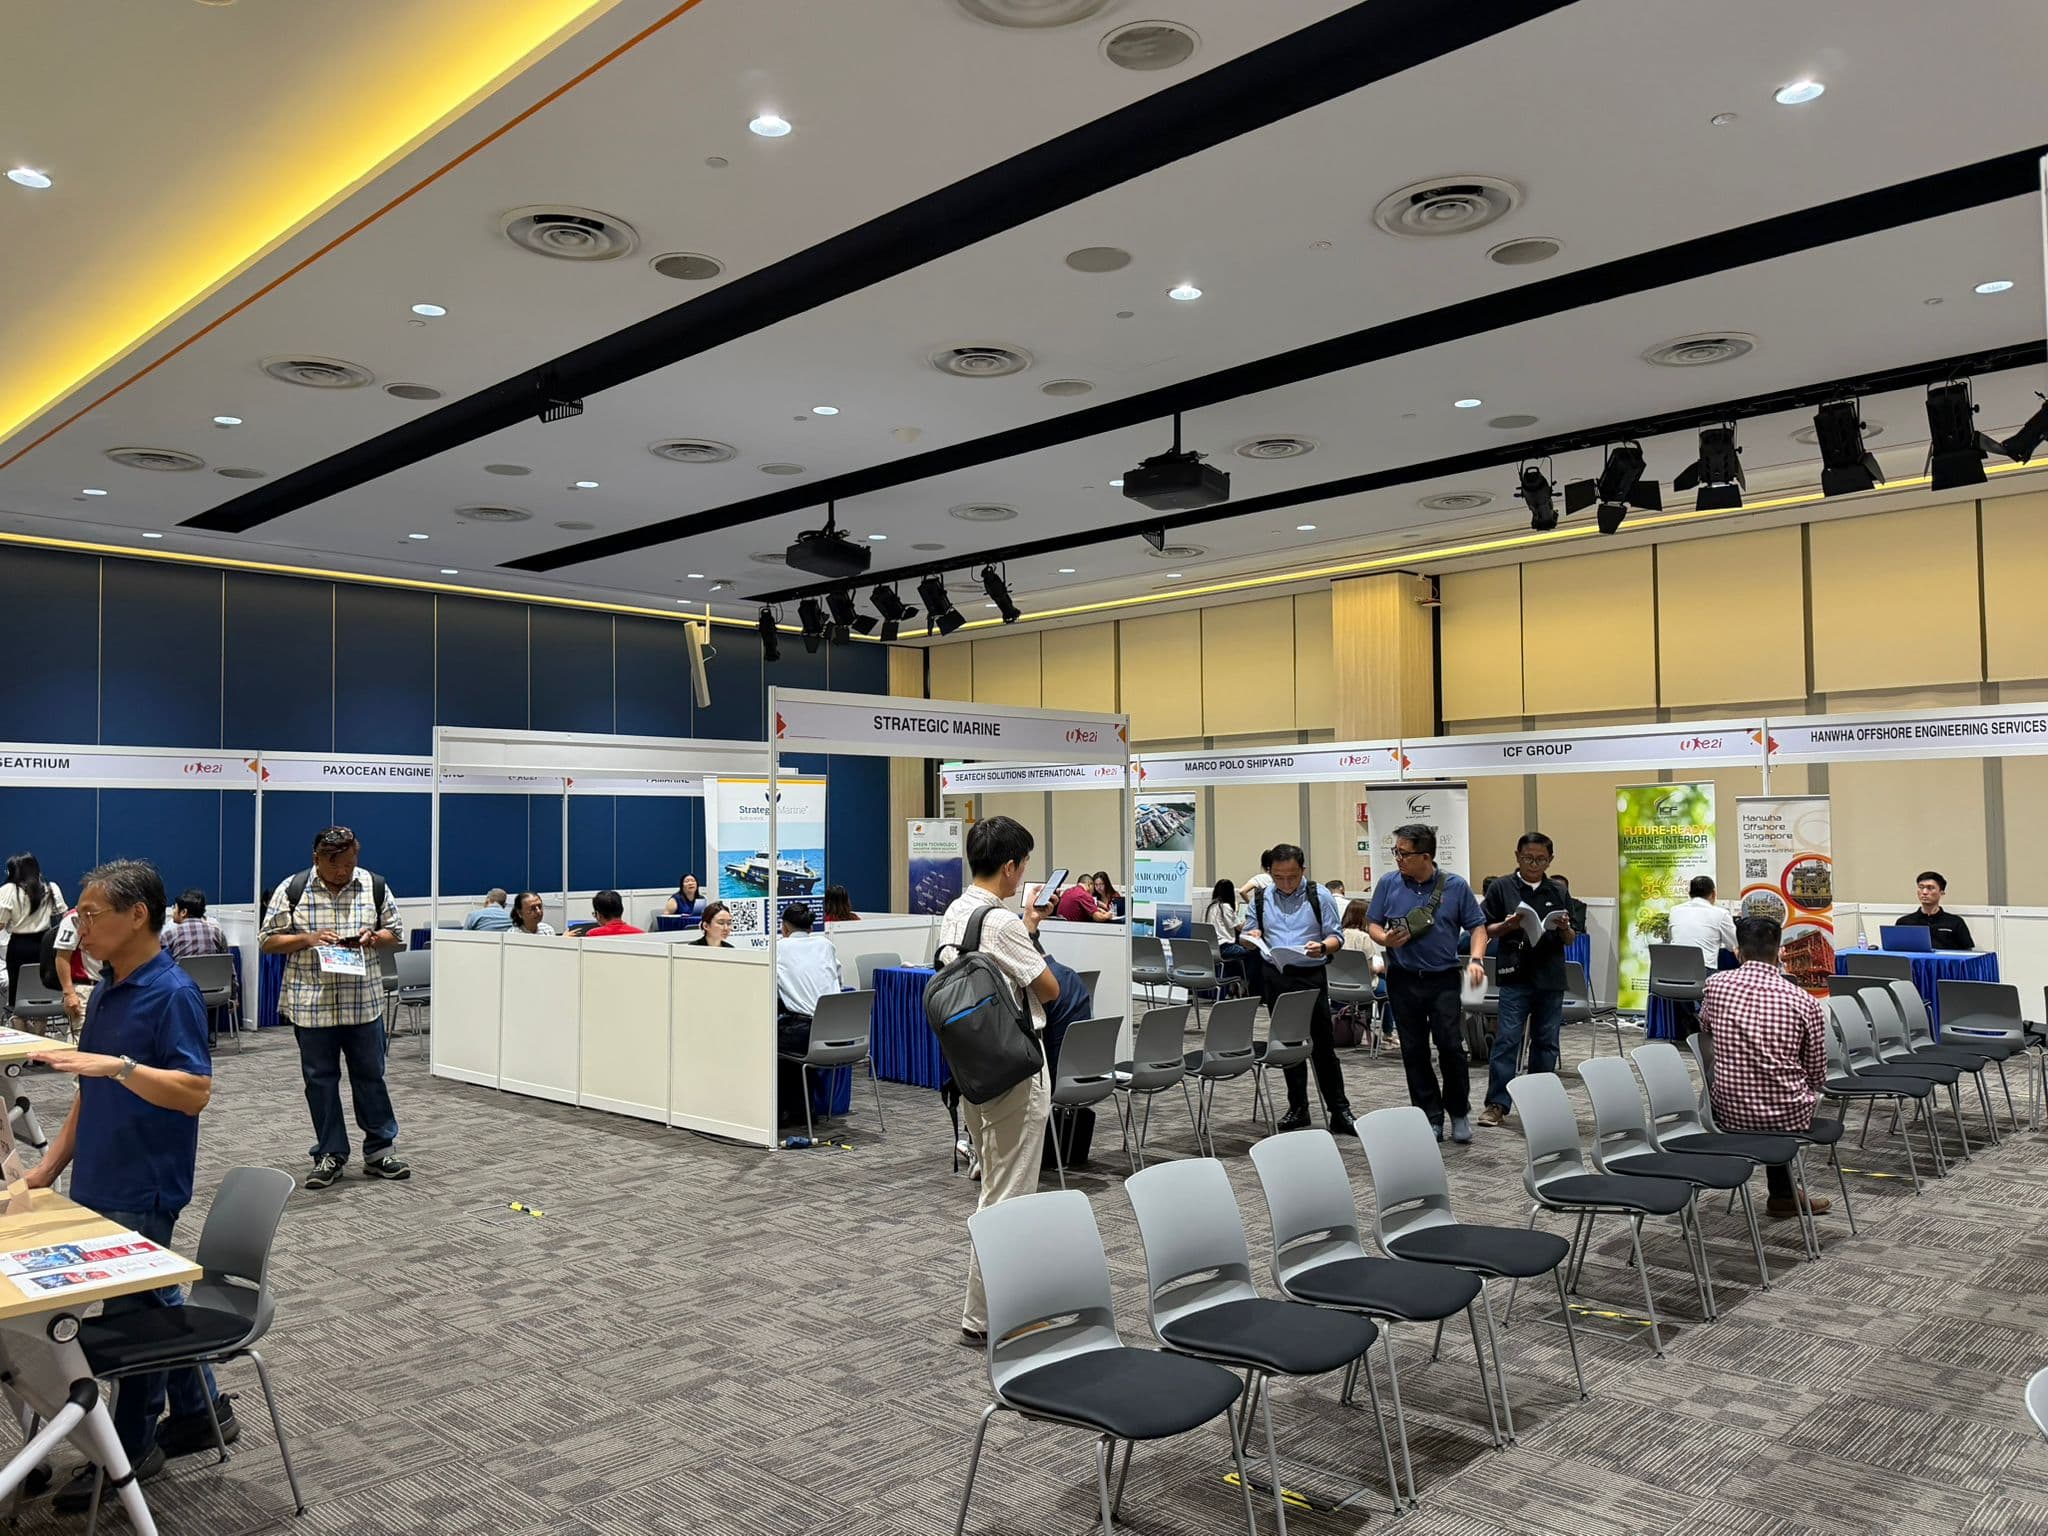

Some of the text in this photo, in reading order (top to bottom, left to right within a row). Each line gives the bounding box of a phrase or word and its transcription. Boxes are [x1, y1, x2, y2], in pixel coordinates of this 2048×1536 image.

[873, 715, 1001, 737] STRATEGIC MARINE
[1810, 720, 2047, 742] HANWHA OFFSHORE ENGINEERING SERVICES
[1503, 744, 1572, 757] ICF GROUP
[1184, 757, 1294, 771] MARCO POLO SHIPYARD
[323, 765, 386, 776] PAXOCEAN
[955, 768, 1086, 781] SEATECH SOLUTIONS INTERNATIONAL
[739, 805, 774, 815] Strateg
[1412, 805, 1431, 813] ICF
[1623, 824, 1709, 836] FUTURE-READY
[1743, 823, 1786, 831] Offshore
[1623, 834, 1708, 845] MARINE INTERIOR
[1744, 832, 1793, 840] Singapore
[1641, 885, 1661, 899] 35
